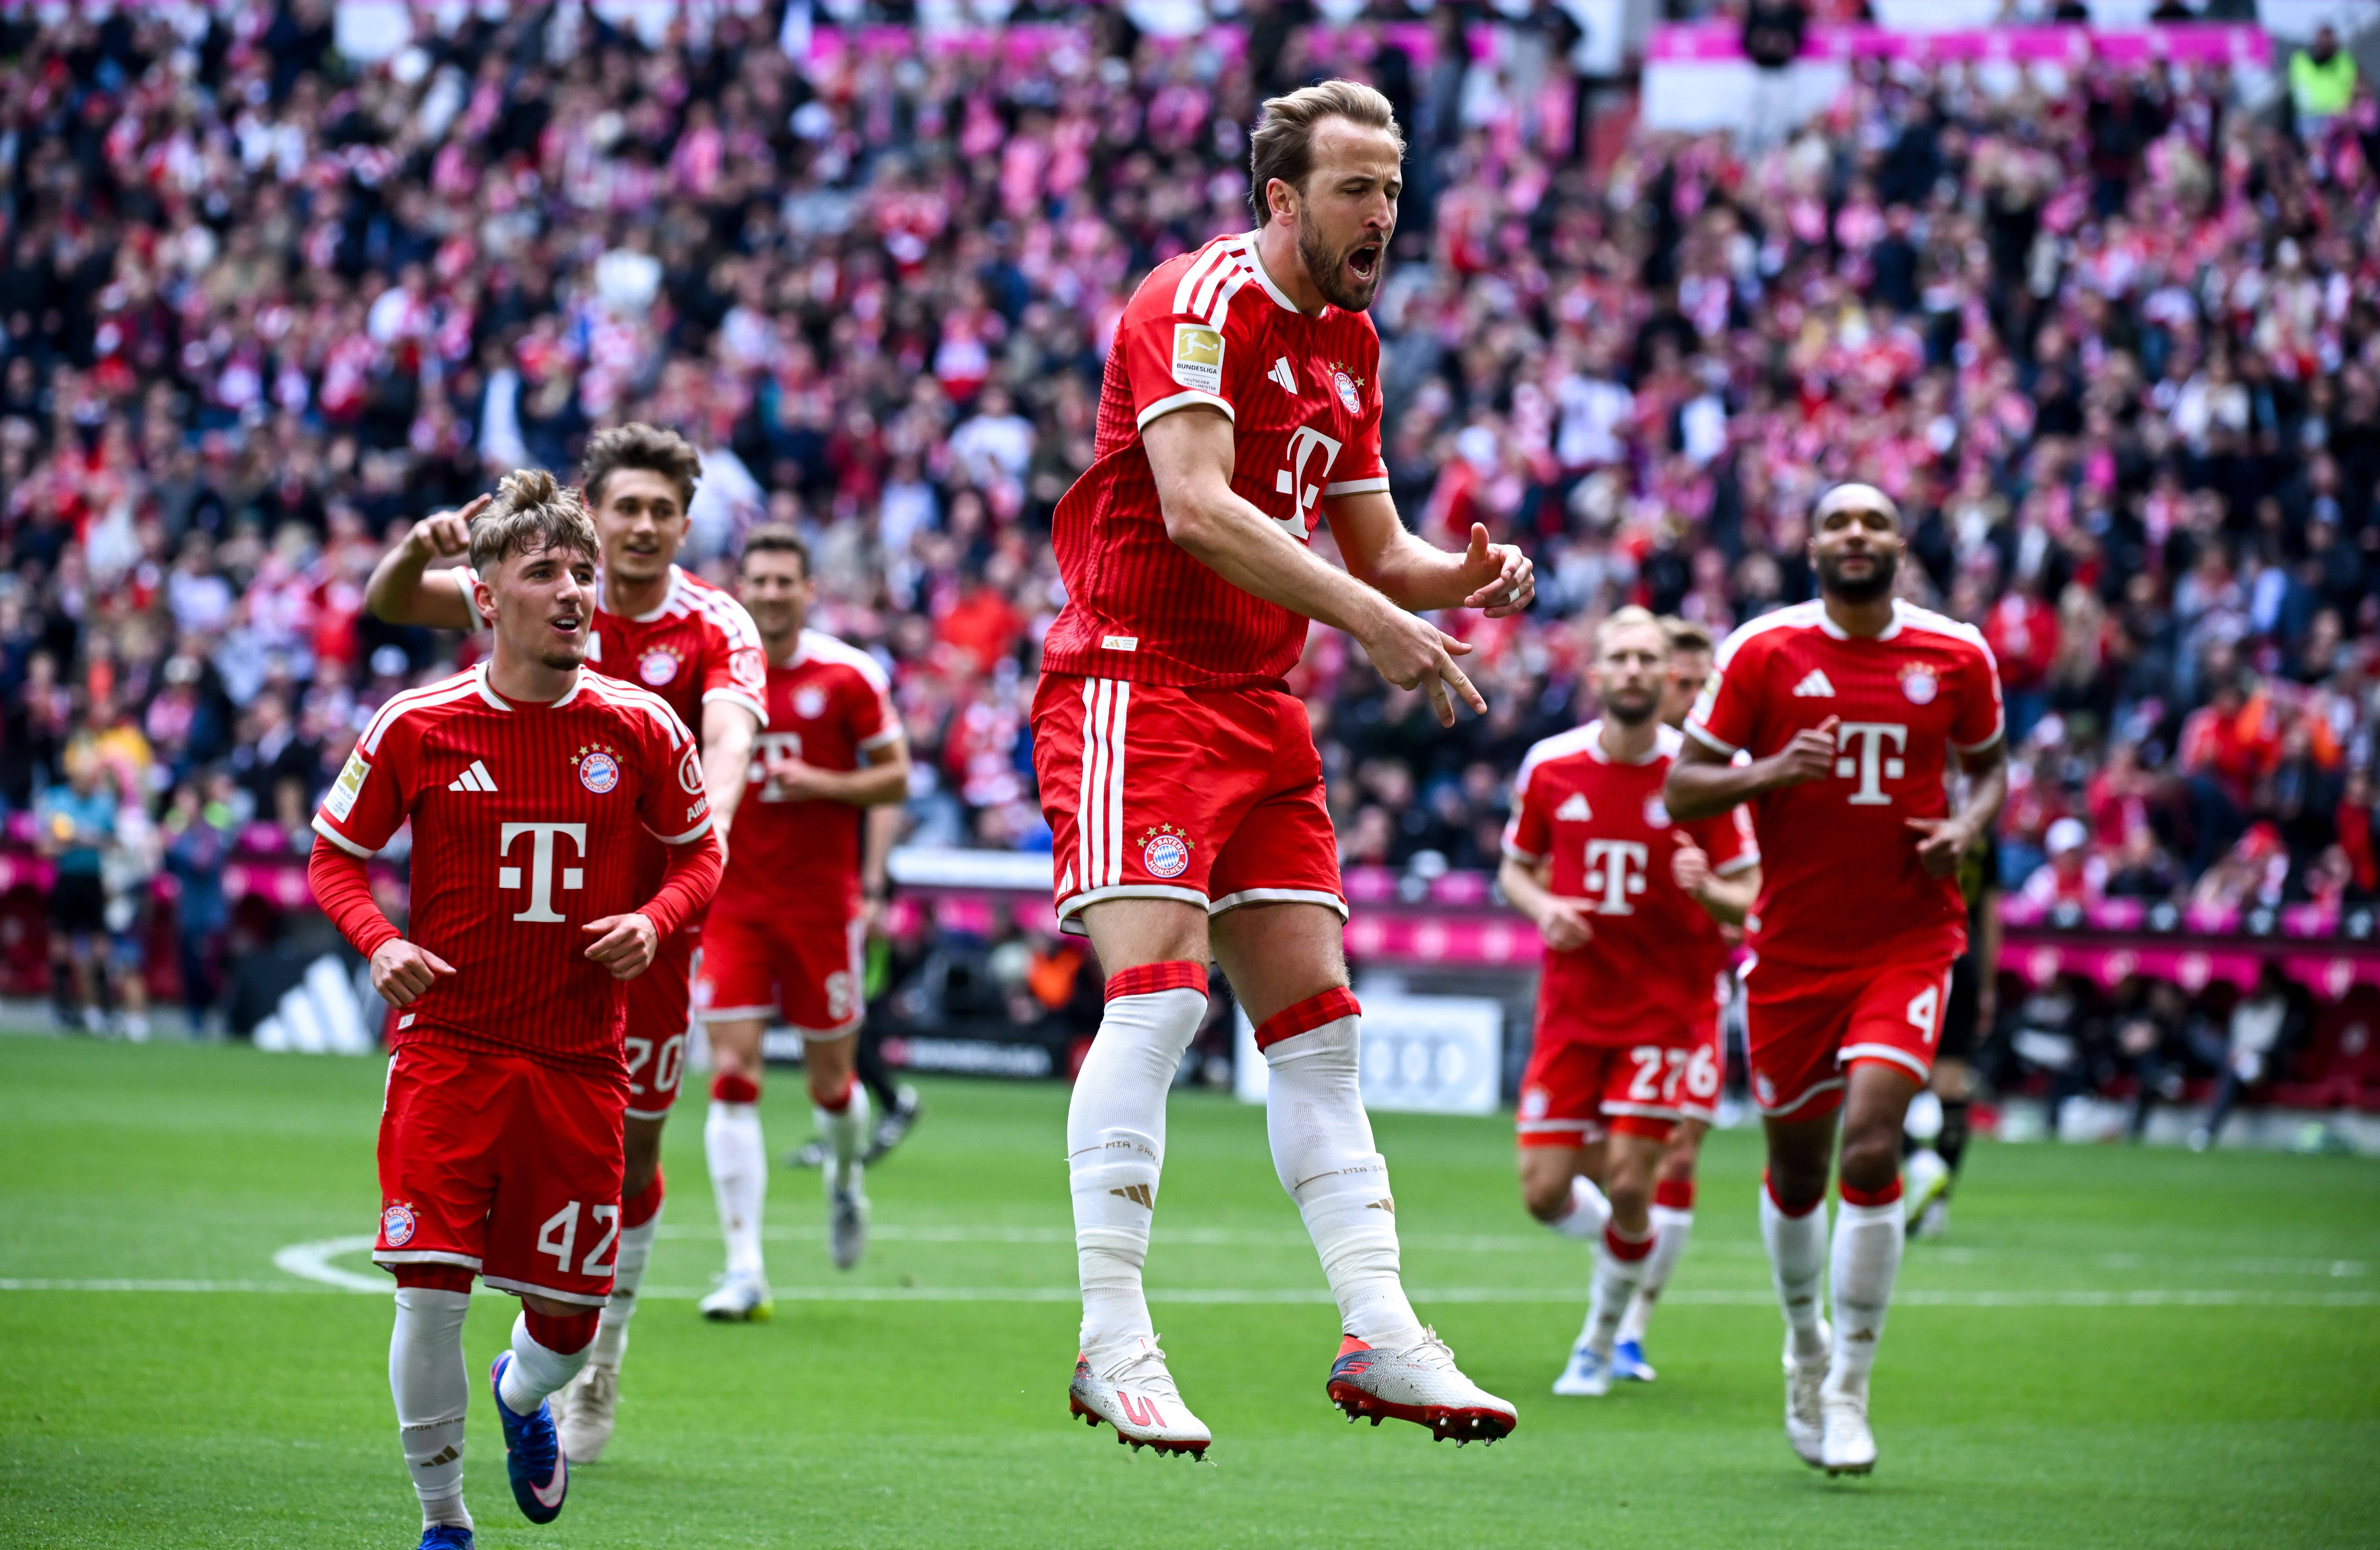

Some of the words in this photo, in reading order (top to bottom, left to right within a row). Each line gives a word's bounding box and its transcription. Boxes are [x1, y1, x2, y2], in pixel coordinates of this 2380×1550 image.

[1177, 363, 1217, 375] BUNDESLIGA
[1272, 425, 1343, 541] T
[1836, 721, 1908, 805] T
[499, 823, 586, 922] T
[1148, 844, 1157, 854] FC
[1157, 838, 1185, 855] BAYERN
[1584, 839, 1648, 915] T
[1907, 984, 1938, 1044] 4
[625, 1033, 684, 1096] 20
[537, 1200, 618, 1277] 42
